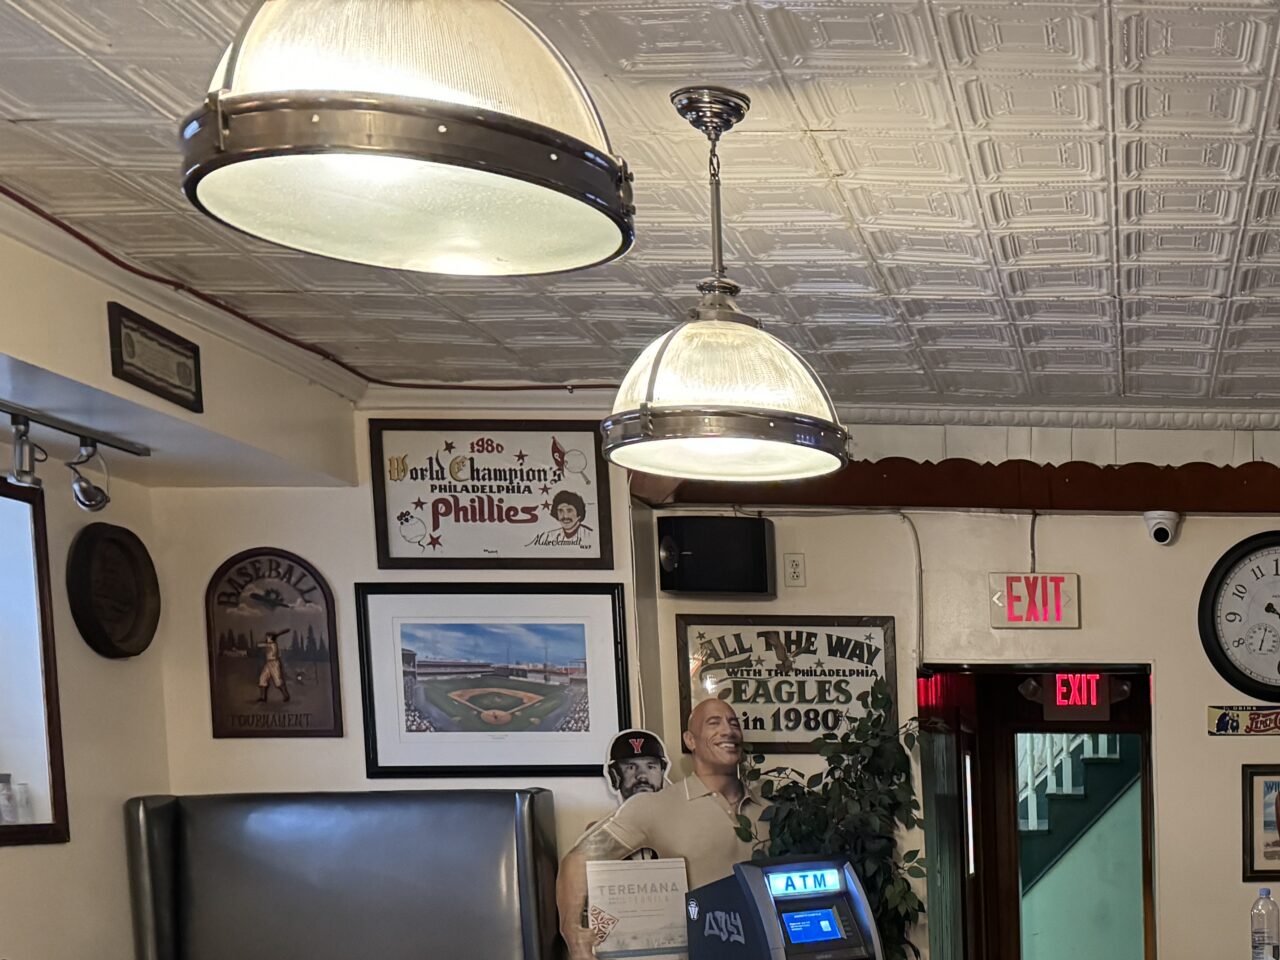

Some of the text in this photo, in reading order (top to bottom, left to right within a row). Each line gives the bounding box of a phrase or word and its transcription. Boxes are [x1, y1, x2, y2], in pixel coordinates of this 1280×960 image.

[469, 437, 504, 453] 1980
[388, 449, 447, 482] World
[432, 494, 539, 532] Phillies
[217, 558, 318, 607] BASEBALL
[1251, 565, 1266, 581] 11
[1006, 575, 1065, 622] EXIT
[1231, 583, 1248, 601] 10
[1225, 611, 1243, 623] 9
[699, 630, 882, 667] ALL THE WAY
[1232, 637, 1245, 648] 8
[726, 667, 762, 678] WITH
[731, 678, 853, 705] EAGLES
[1055, 673, 1100, 706] EXIT
[230, 713, 313, 729] TOURNAMENT
[743, 708, 842, 732] in 1980
[597, 881, 680, 897] TEREMANA
[785, 872, 827, 891] ATM
